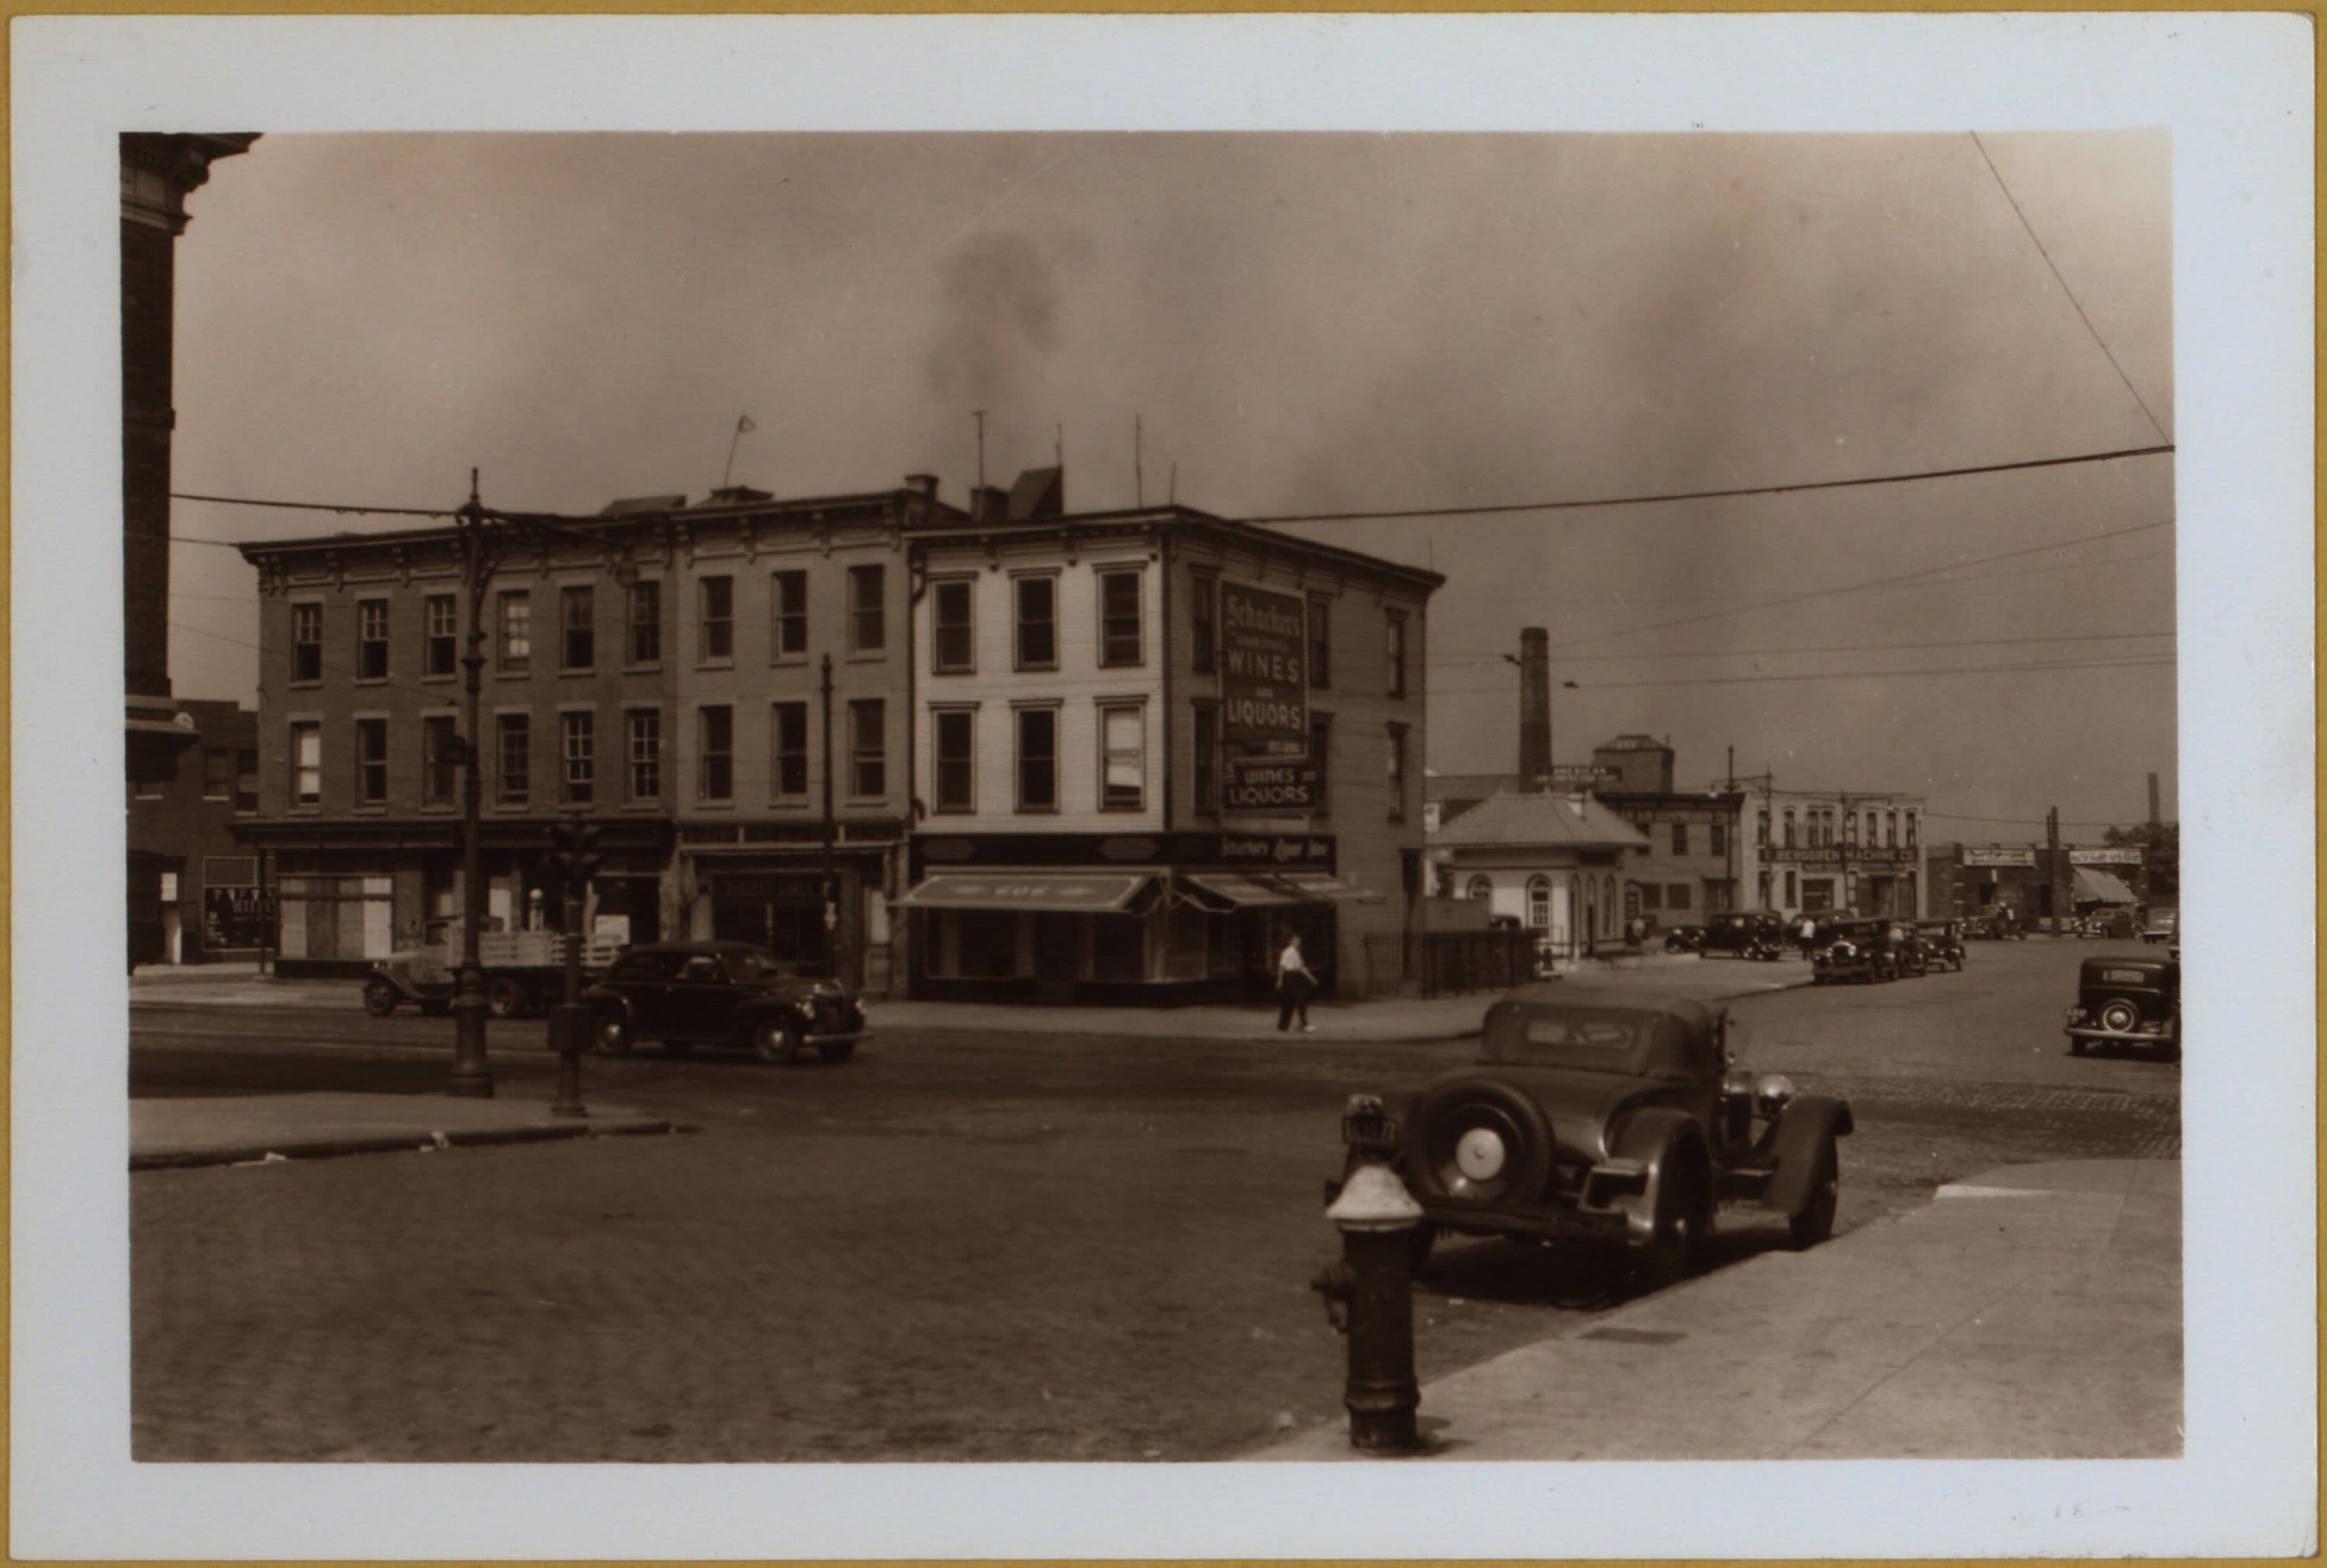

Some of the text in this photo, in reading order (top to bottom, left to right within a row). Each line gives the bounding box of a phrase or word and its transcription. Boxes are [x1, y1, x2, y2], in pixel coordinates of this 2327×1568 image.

[1228, 648, 1300, 682] WINES
[1227, 697, 1302, 730] LIQUORS
[1229, 785, 1309, 806] LIQUORS
[1845, 849, 1897, 862] MACHINE
